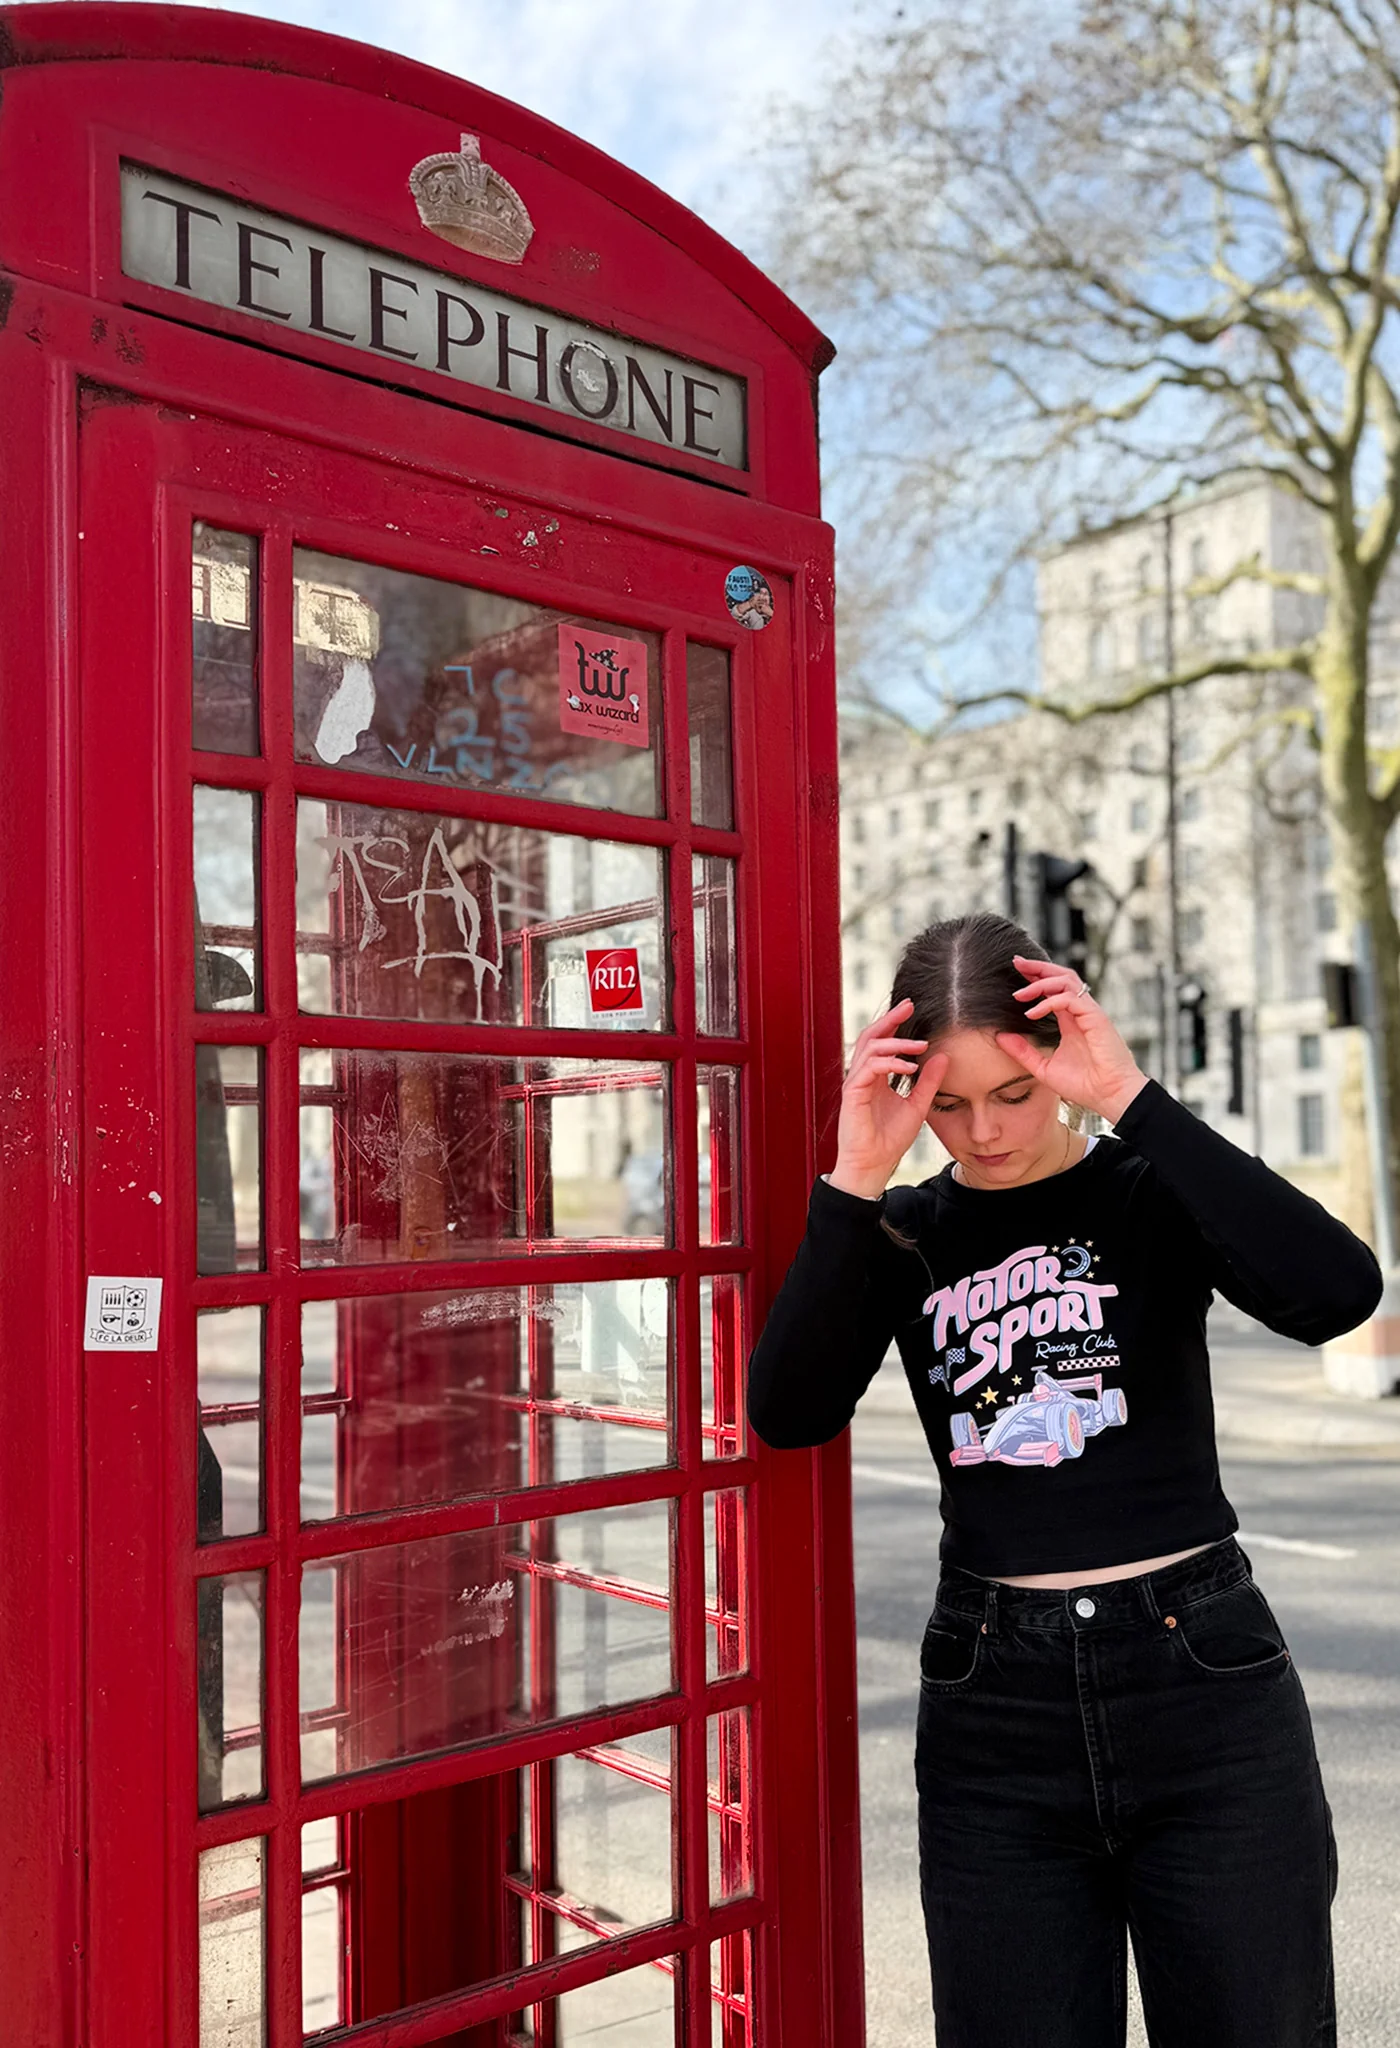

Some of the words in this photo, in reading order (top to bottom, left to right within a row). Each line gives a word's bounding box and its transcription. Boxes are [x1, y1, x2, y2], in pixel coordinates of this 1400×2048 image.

[142, 190, 721, 456] TELEPHONE
[595, 965, 636, 991] RTL2
[922, 1245, 1067, 1351] MOTOR
[99, 1334, 110, 1342] FC
[111, 1335, 122, 1343] LA
[953, 1280, 1119, 1396] SPORT
[1035, 1340, 1078, 1359] Racing
[1083, 1333, 1118, 1353] Club
